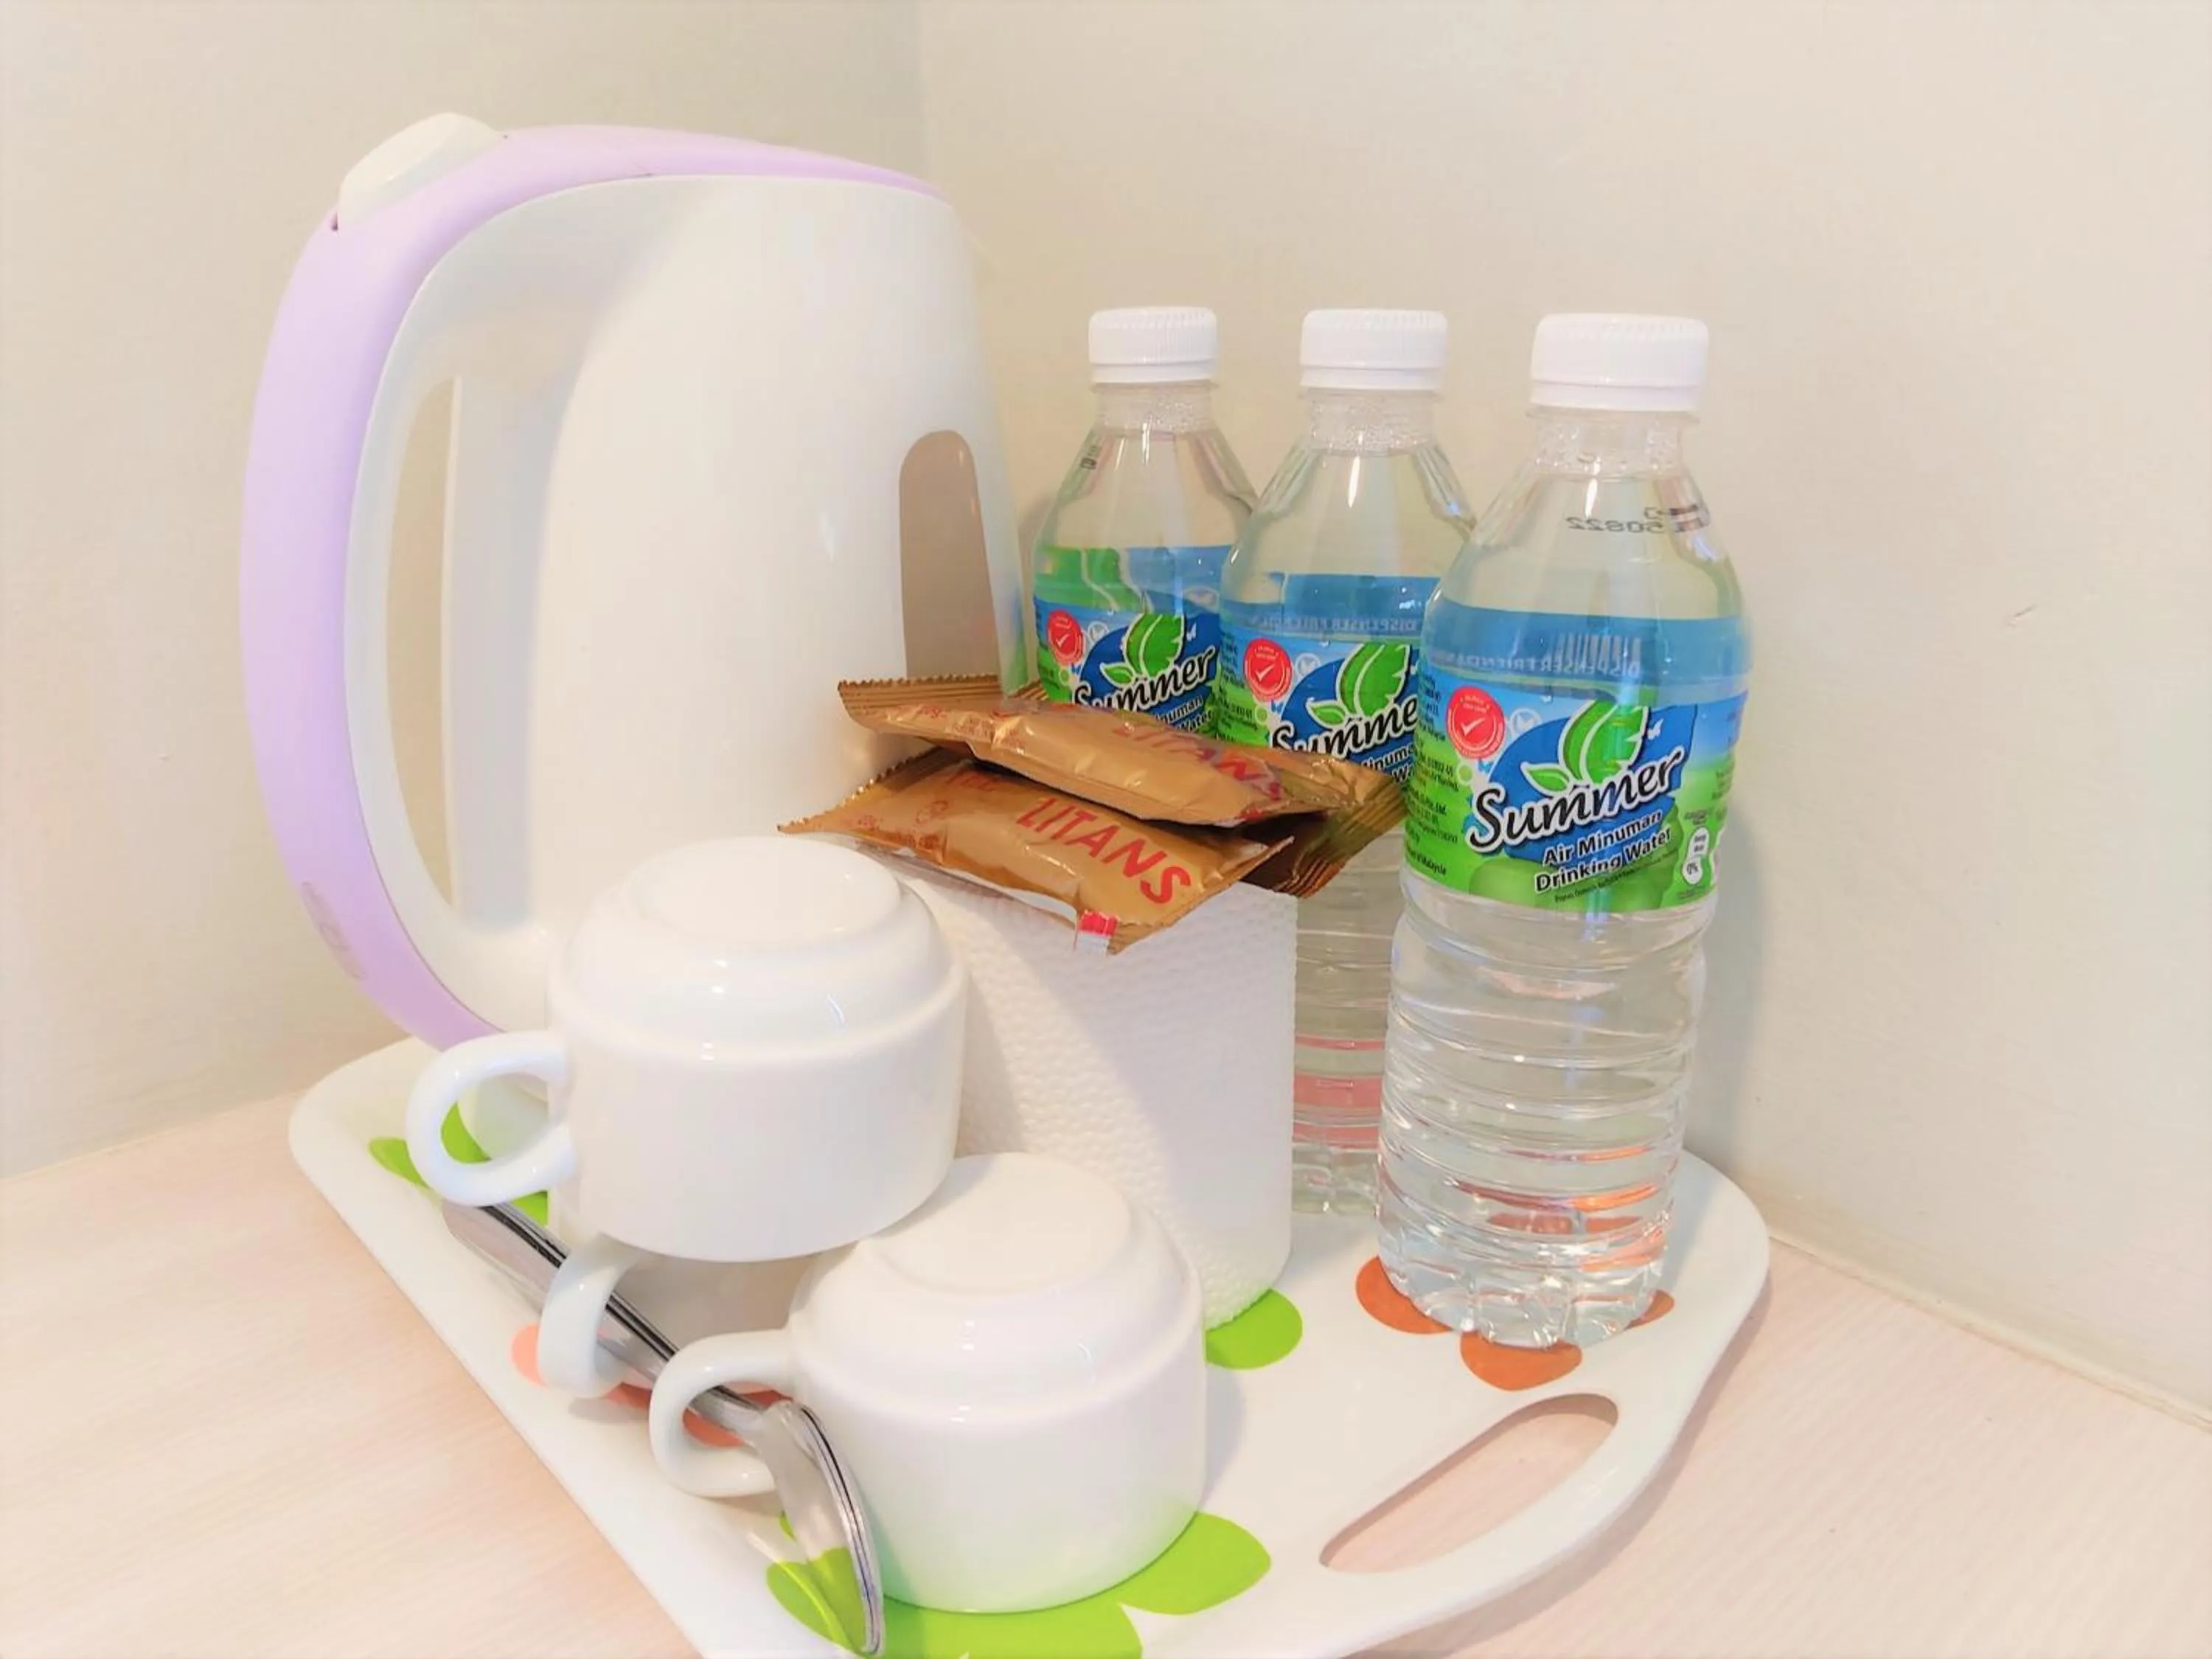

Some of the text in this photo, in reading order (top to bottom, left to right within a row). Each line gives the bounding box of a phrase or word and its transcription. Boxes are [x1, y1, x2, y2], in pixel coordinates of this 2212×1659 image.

[1467, 746, 1685, 850] Summer
[1543, 843, 1574, 866] Air
[1576, 810, 1663, 858] Minuman
[1016, 796, 1192, 905] LITANS
[1534, 853, 1622, 894] Drinking
[1624, 825, 1672, 863] Water
